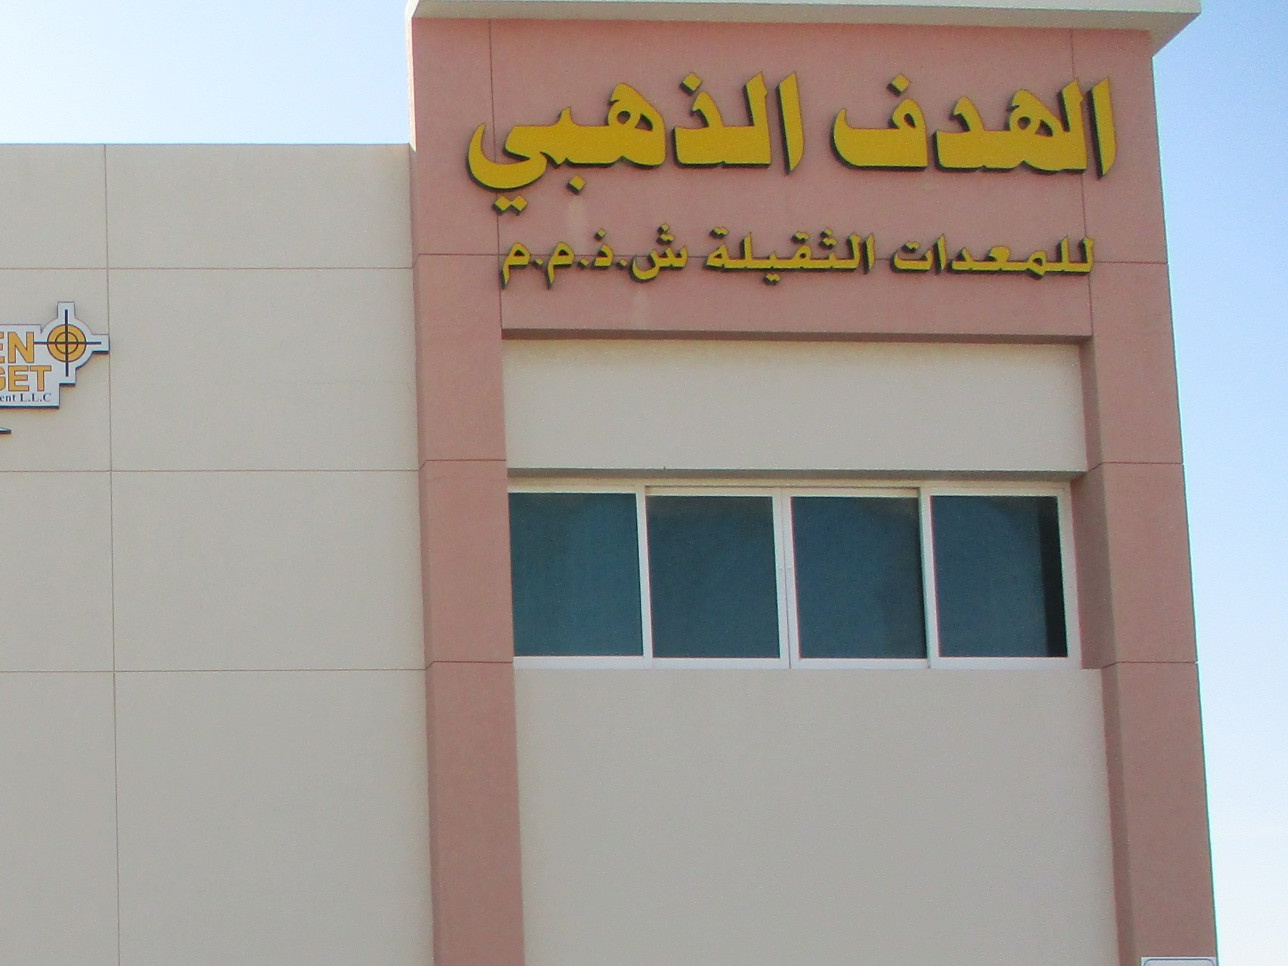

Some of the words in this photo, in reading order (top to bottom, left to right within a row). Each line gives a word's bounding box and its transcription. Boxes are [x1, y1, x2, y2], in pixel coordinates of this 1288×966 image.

[466, 71, 806, 214] الذهبي
[832, 74, 1119, 178] الهدف
[705, 228, 876, 286] الثقيلة
[892, 234, 1096, 281] للمعدات
[20, 393, 52, 403] L.L.C
